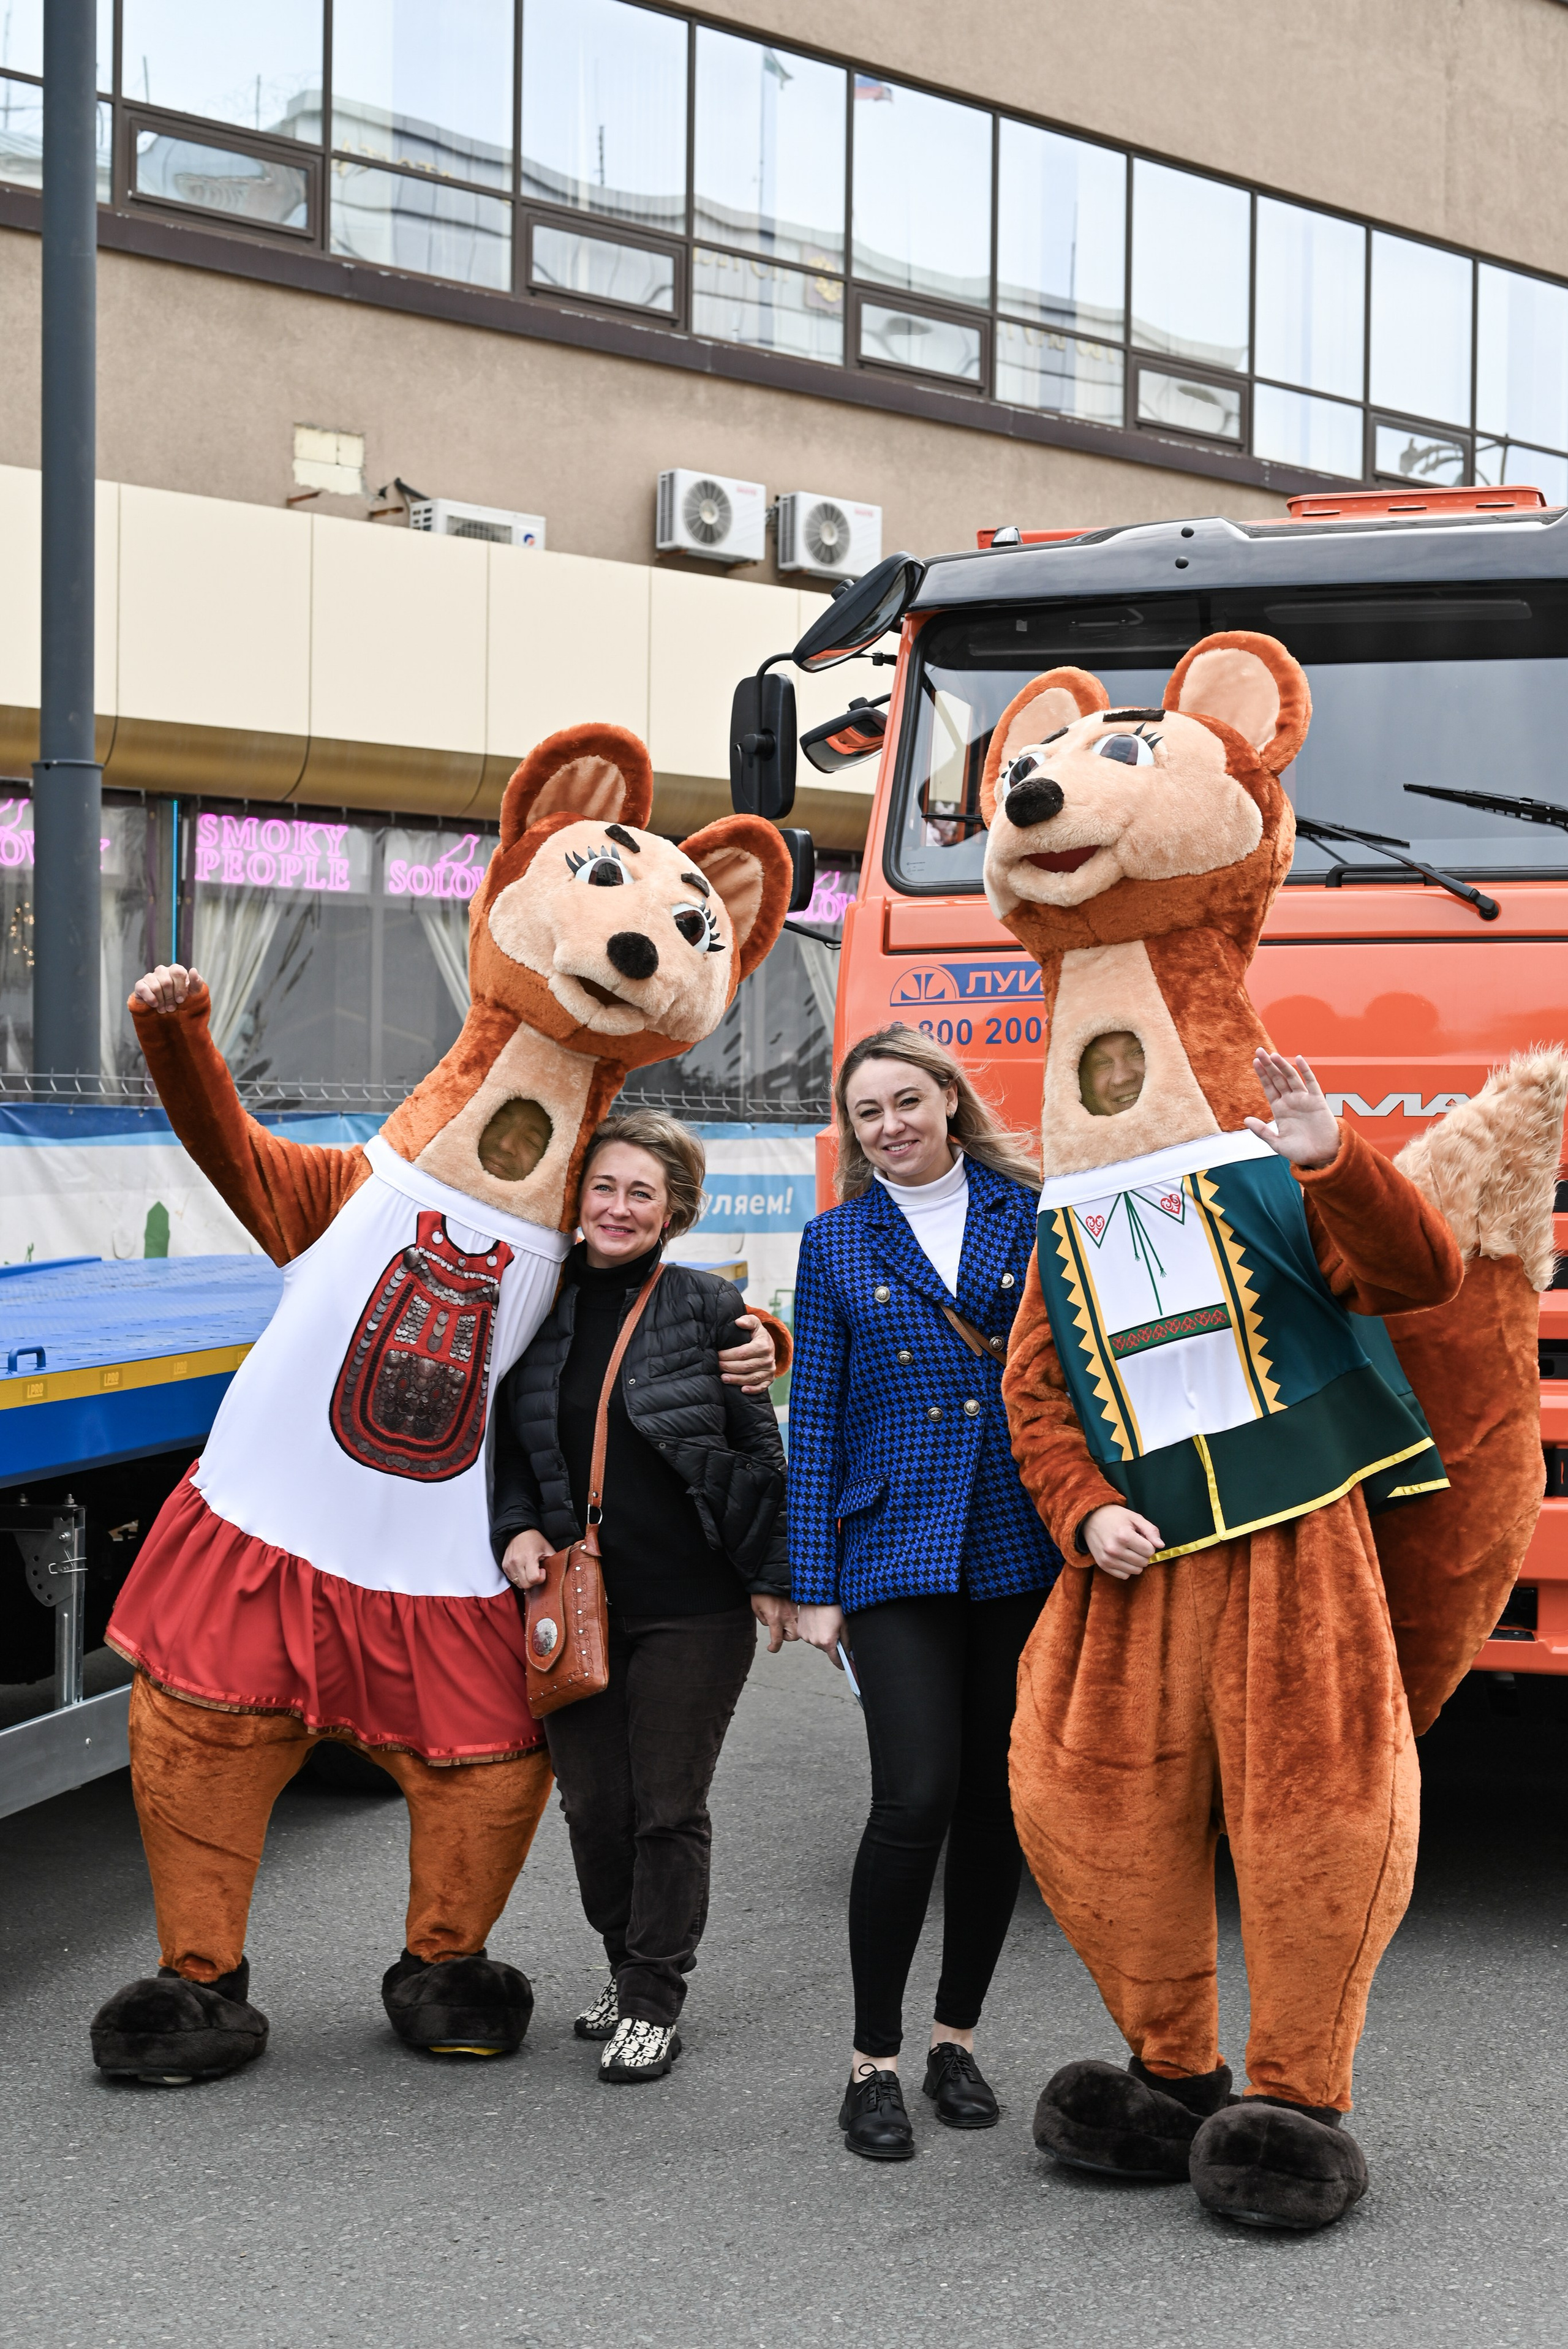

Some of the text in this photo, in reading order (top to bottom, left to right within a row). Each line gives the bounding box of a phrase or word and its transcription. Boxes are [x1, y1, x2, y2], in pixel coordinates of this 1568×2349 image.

[197, 813, 349, 857] SMOKY
[195, 847, 350, 891] PEOPLE
[985, 1016, 1049, 1044] 200
